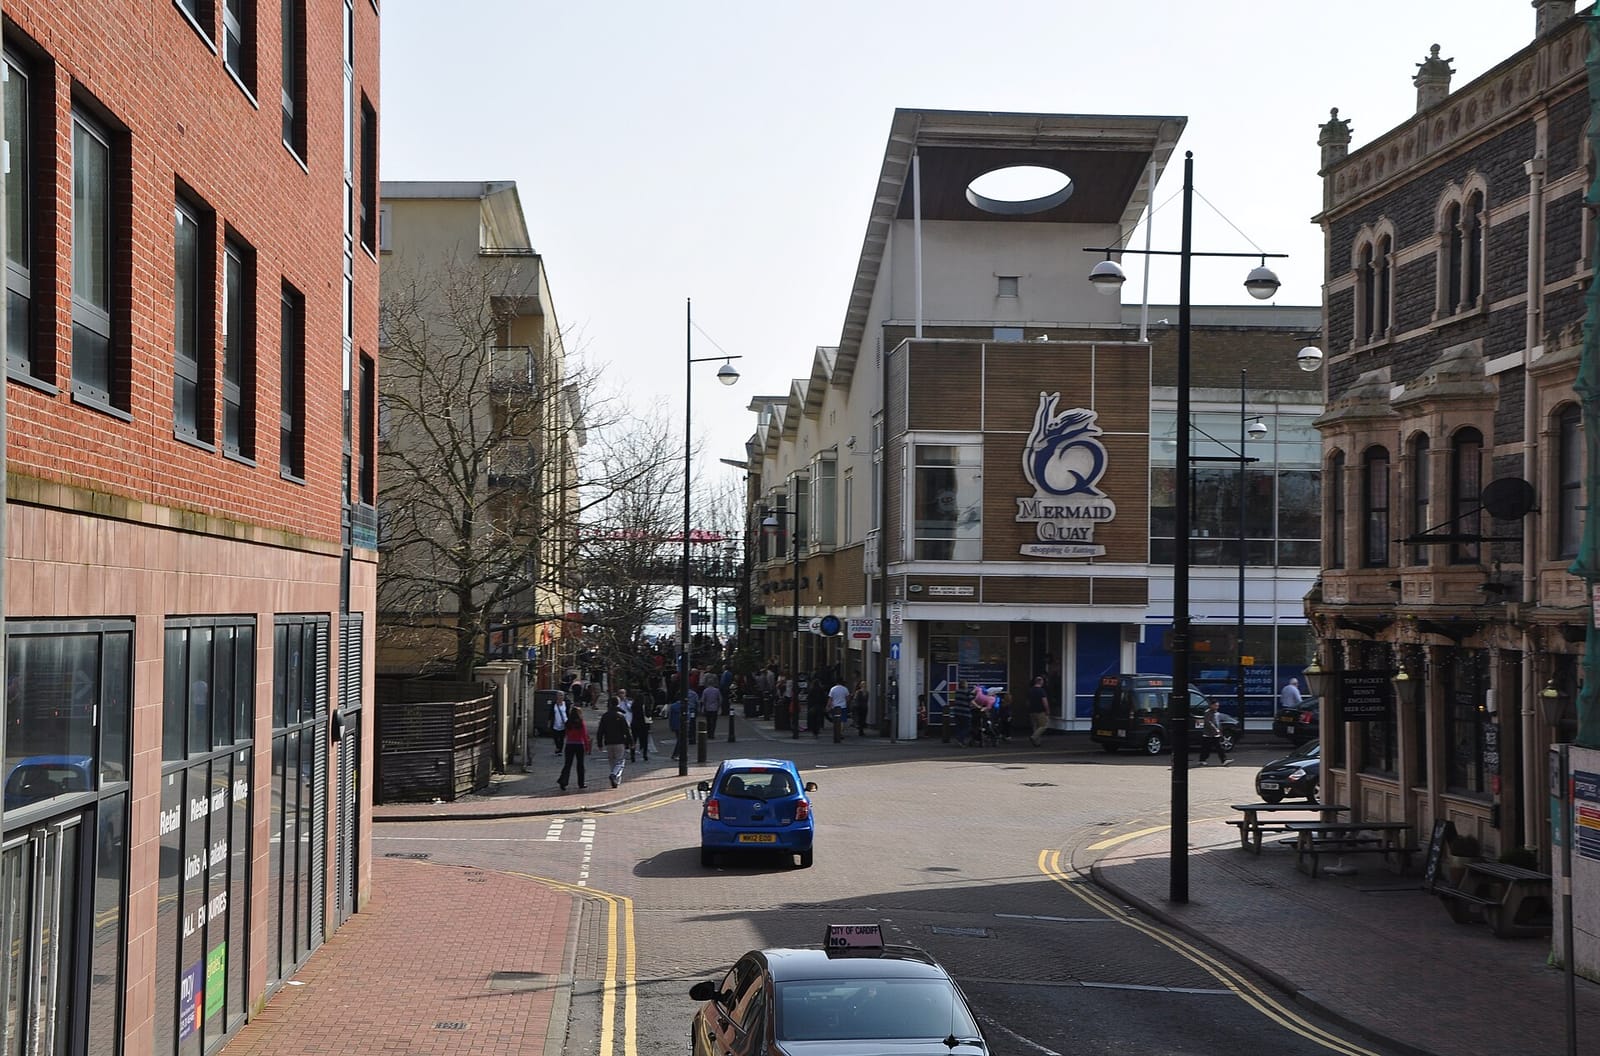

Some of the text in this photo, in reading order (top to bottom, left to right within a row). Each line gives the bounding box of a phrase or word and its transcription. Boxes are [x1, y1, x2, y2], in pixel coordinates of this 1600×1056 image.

[1019, 500, 1112, 519] MERMAID
[1040, 522, 1091, 540] QUAY
[1030, 546, 1096, 555] Shopping & Eating
[160, 779, 248, 836] Retail Restarant Office
[185, 839, 228, 880] Units Aailable
[184, 891, 227, 938] ALL ENUIRIES
[831, 926, 878, 935] CITY OF CARDIFF
[831, 937, 850, 946] NO.
